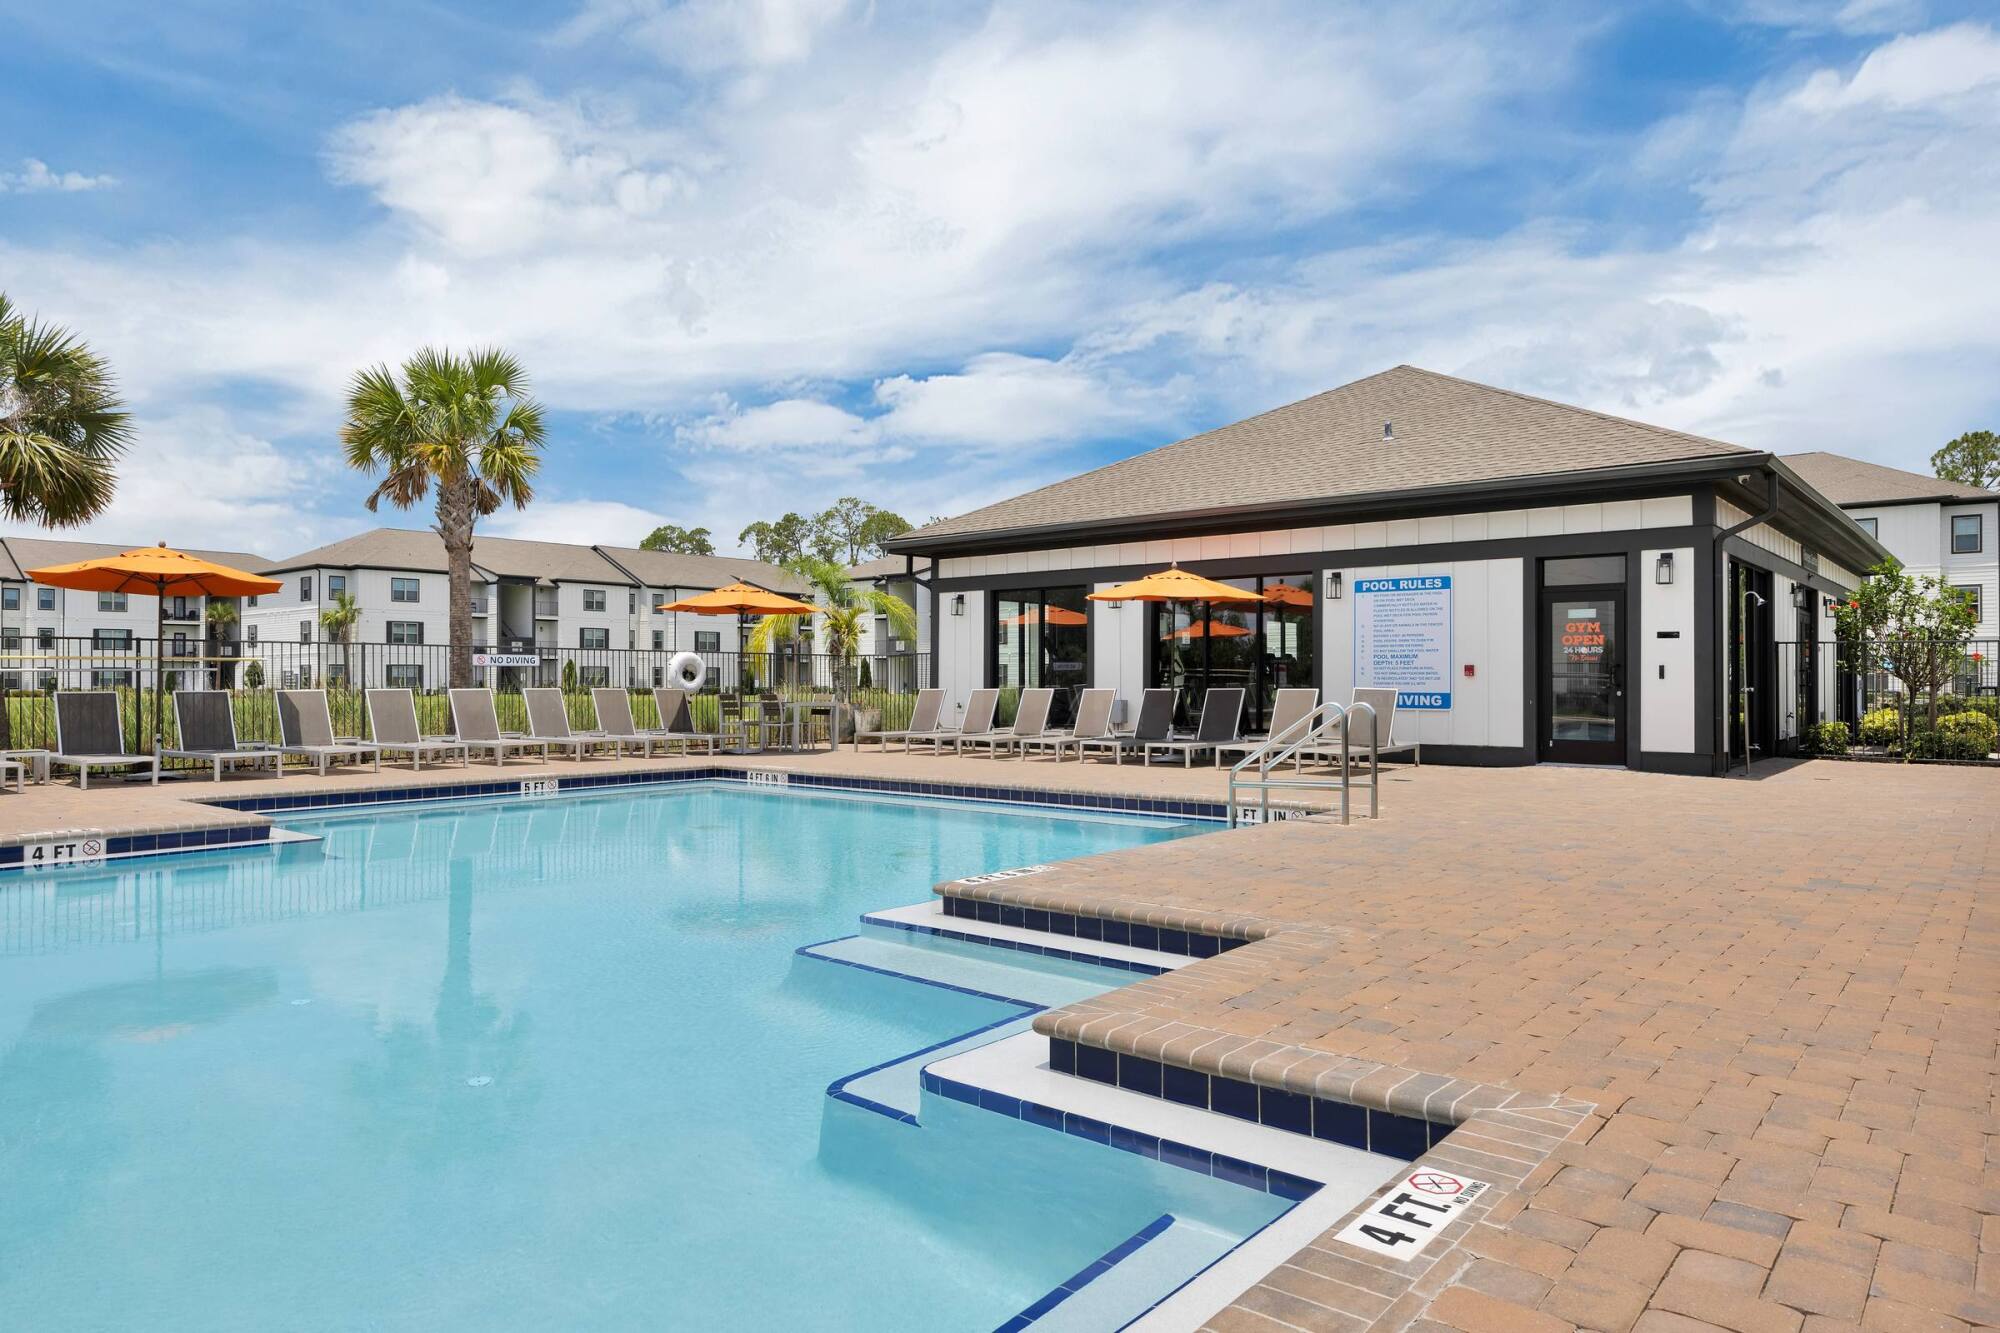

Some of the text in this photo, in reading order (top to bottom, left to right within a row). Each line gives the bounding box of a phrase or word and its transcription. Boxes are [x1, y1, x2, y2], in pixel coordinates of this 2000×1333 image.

[1362, 578, 1442, 591] POOL RULES
[1565, 622, 1601, 633] GYM
[1561, 634, 1605, 646] OPEN
[1563, 646, 1604, 654] 24 HOURS
[490, 656, 536, 664] NO DIVING
[1398, 694, 1442, 706] IVING
[771, 773, 779, 783] IN
[524, 782, 545, 792] 5 FT
[1243, 808, 1257, 820] FT
[1274, 810, 1287, 822] IN
[32, 844, 77, 860] 4 FT
[1452, 1182, 1487, 1206] NO DIVING
[1358, 1192, 1452, 1246] 4 FT.
